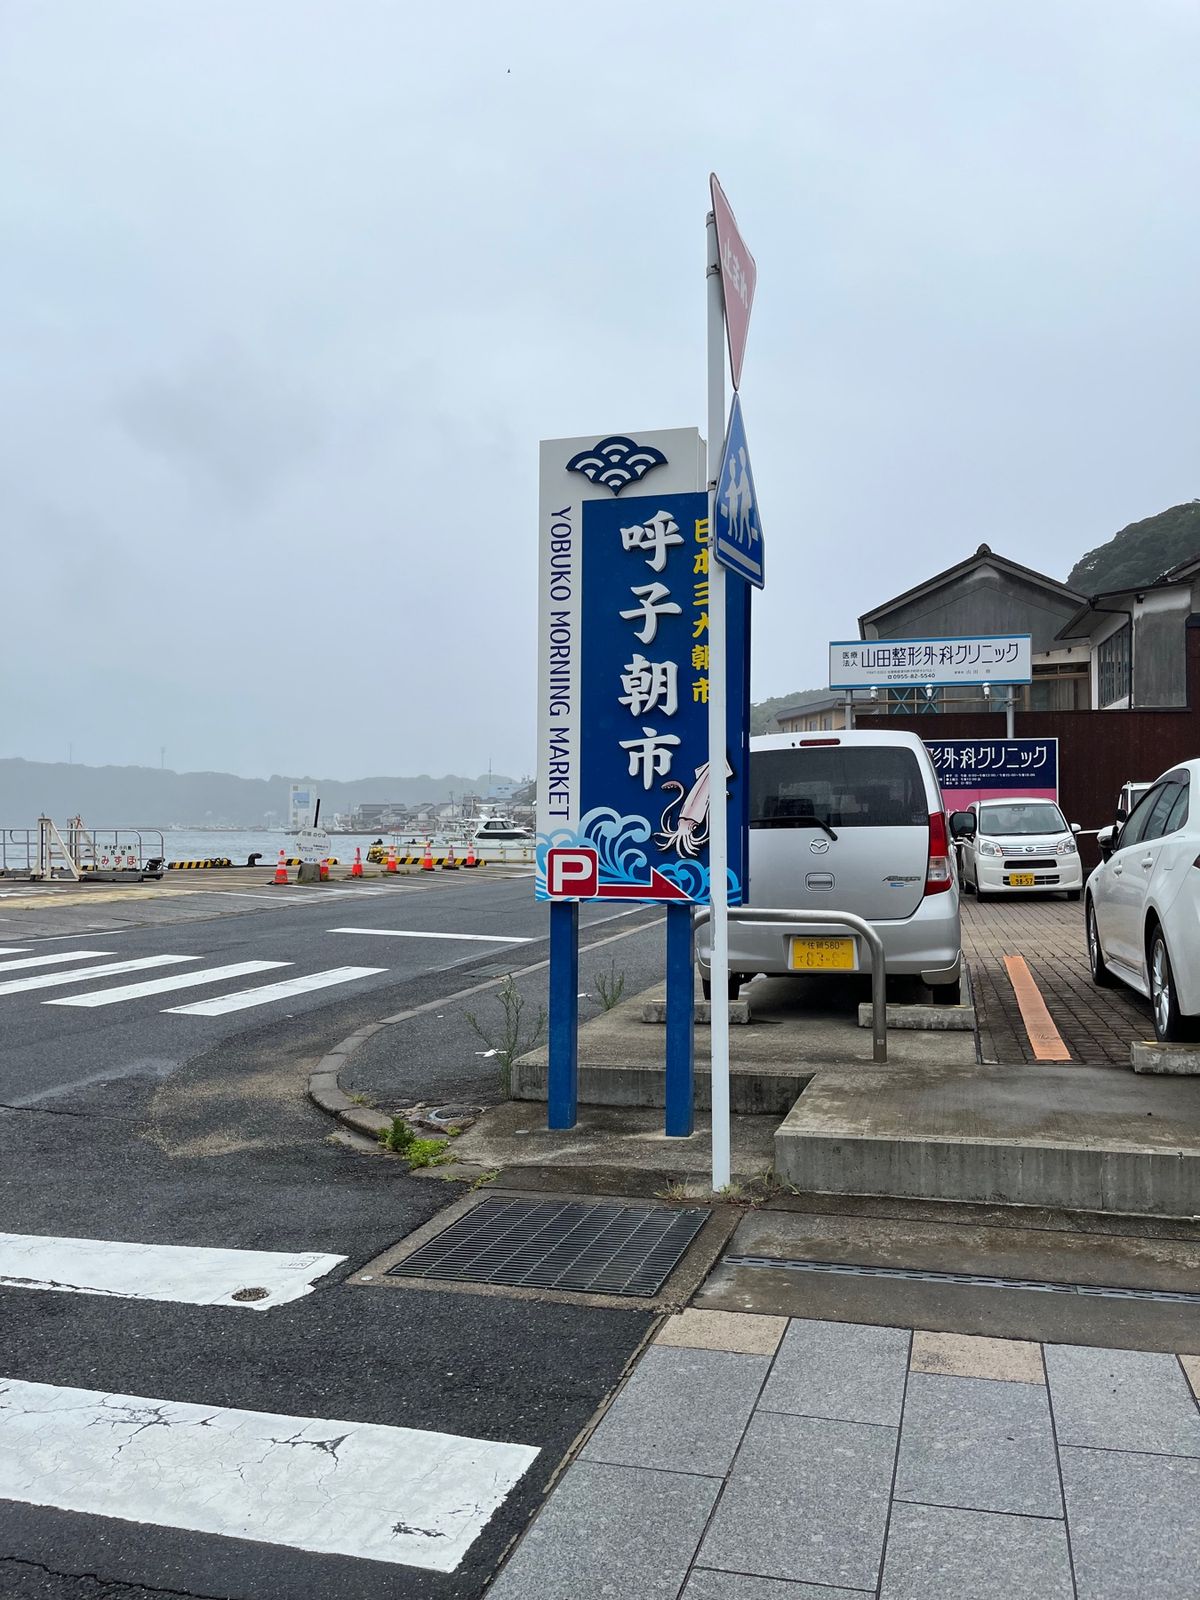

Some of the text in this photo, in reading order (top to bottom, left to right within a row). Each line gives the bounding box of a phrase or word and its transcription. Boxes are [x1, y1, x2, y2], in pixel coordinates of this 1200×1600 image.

[548, 505, 572, 821] YOBUKO MORNING MARKET
[617, 509, 685, 791] 呼子朝市
[842, 651, 858, 659] 医療
[842, 659, 858, 667] 法人
[861, 642, 1019, 668] 山田整形外科クリニック
[552, 854, 593, 892] P
